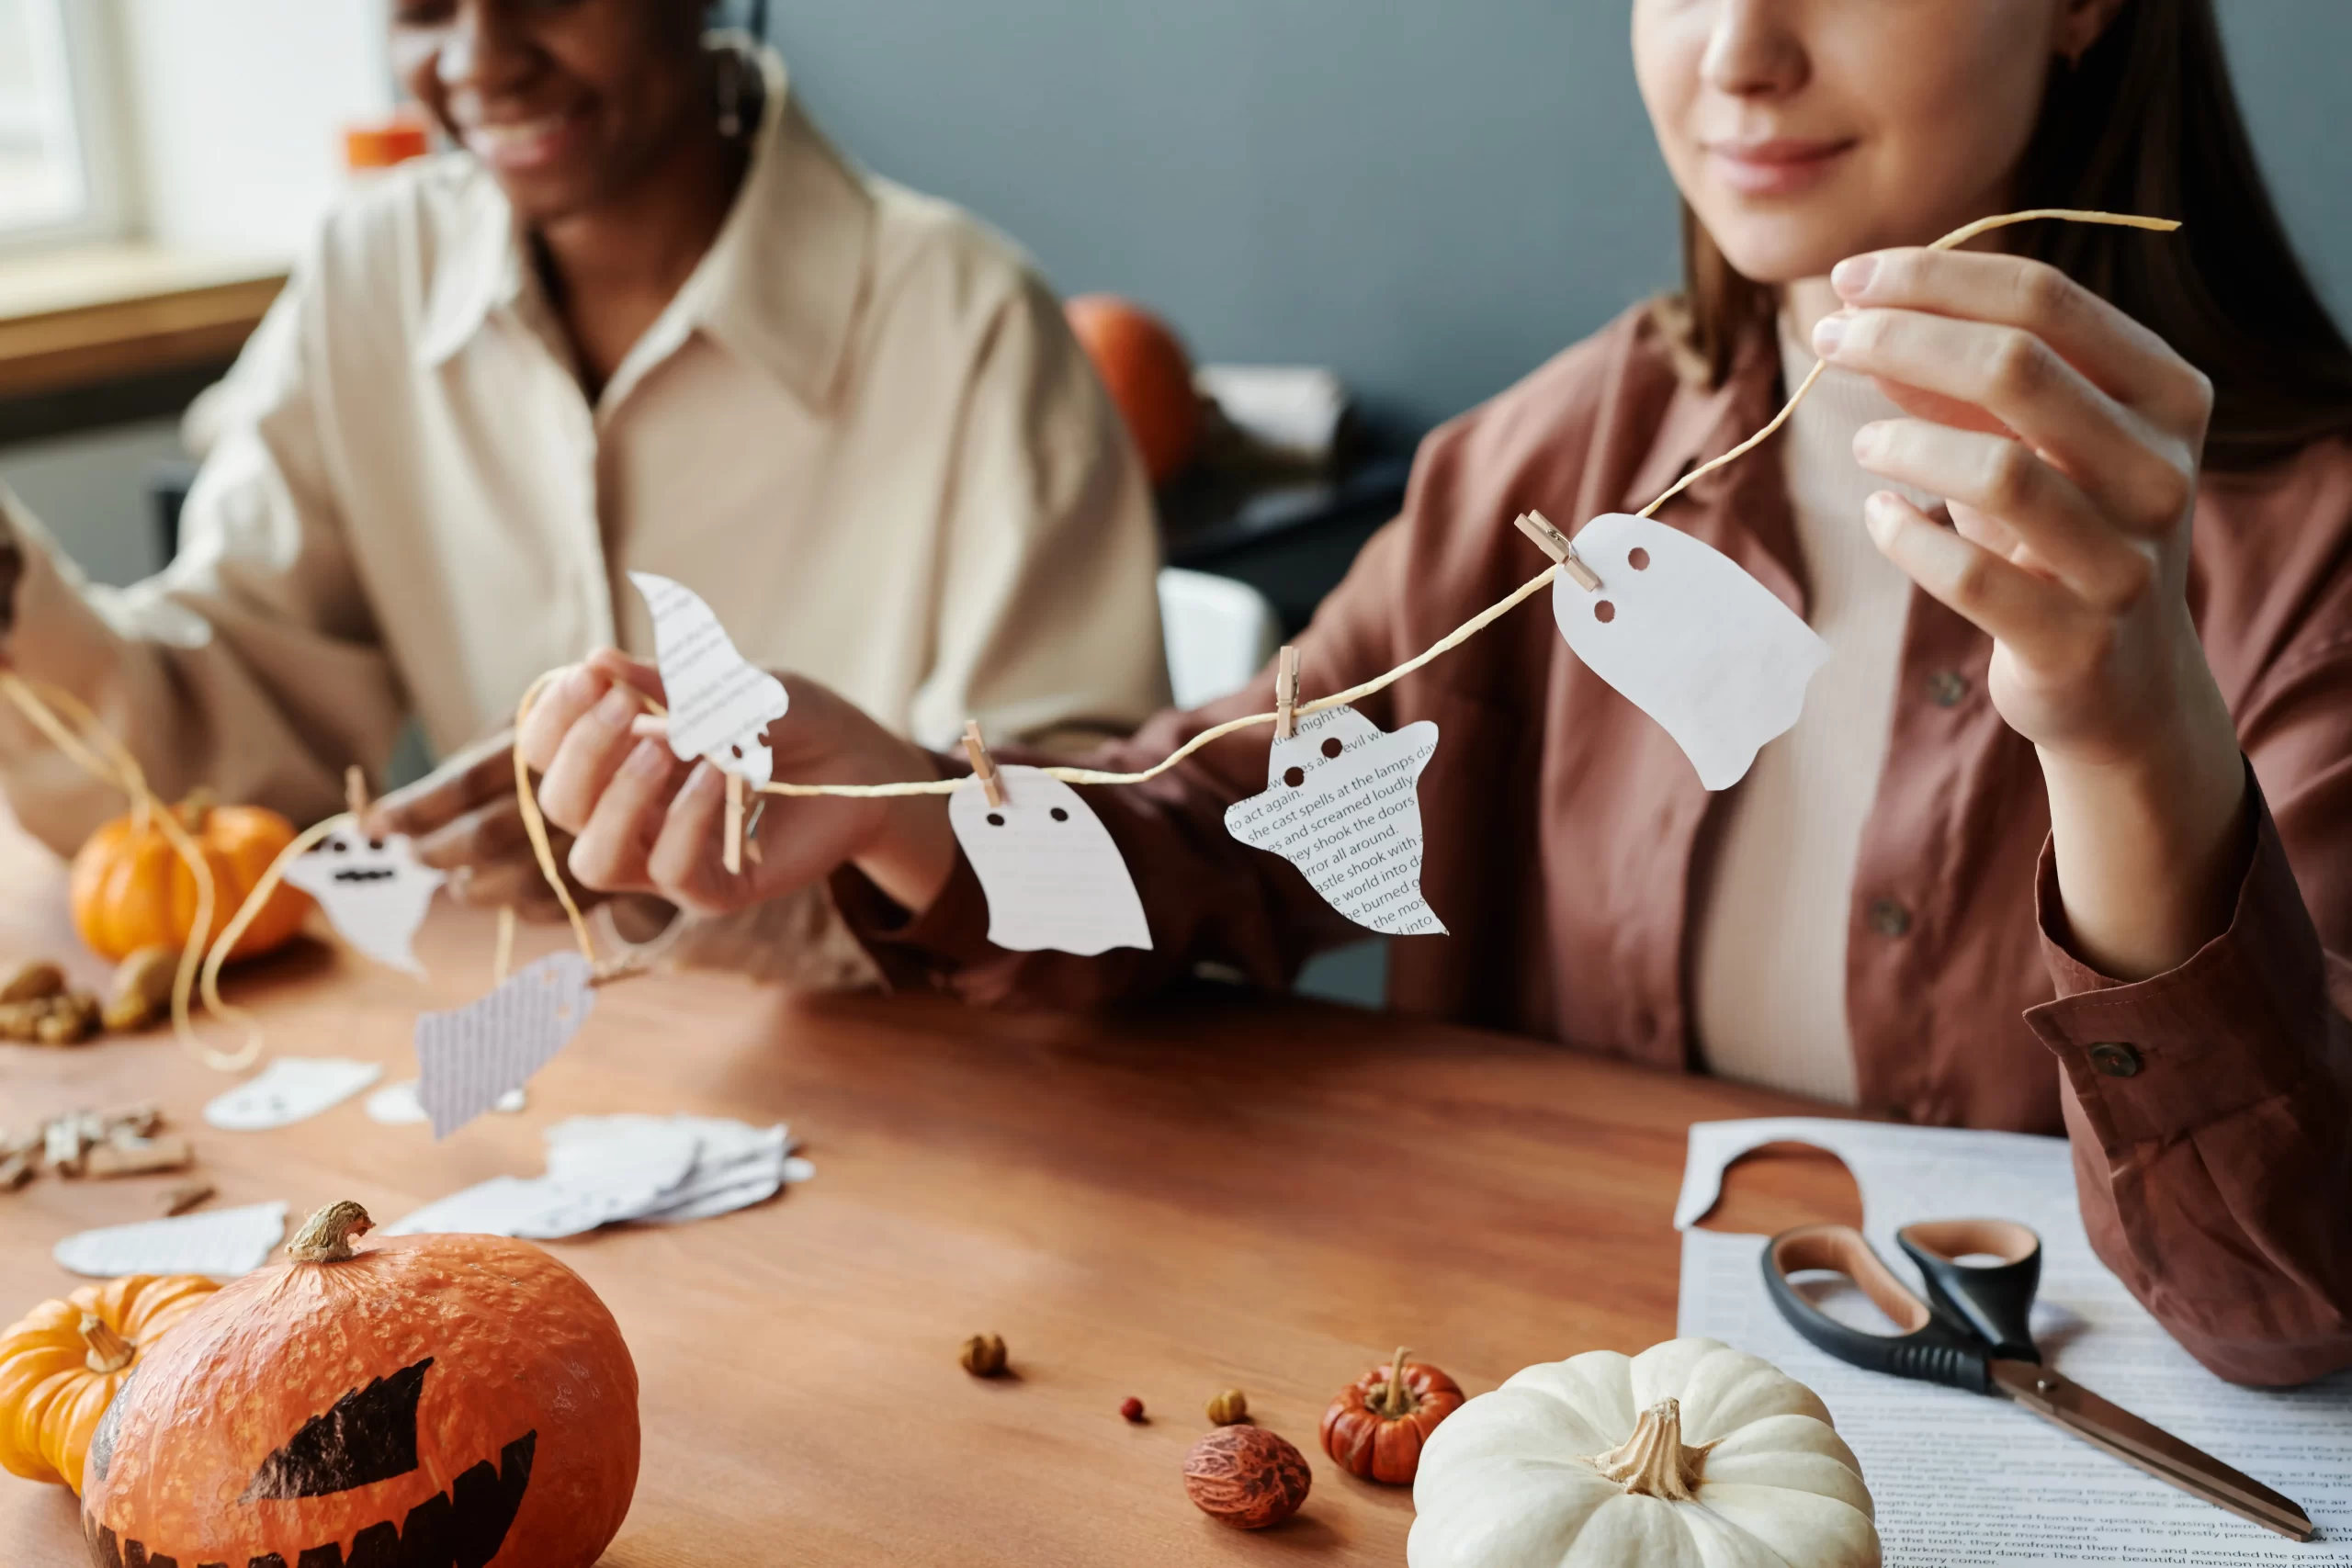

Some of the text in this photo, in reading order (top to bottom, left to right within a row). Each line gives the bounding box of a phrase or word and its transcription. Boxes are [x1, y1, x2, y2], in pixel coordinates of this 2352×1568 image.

[1301, 711, 1337, 732] night
[1337, 705, 1351, 716] to
[1343, 734, 1365, 753] evil
[1229, 820, 1242, 832] to
[1244, 807, 1264, 825] act
[1266, 789, 1305, 814] again.
[1248, 827, 1270, 843] she
[1272, 811, 1298, 830] cast
[1299, 793, 1335, 817] spells
[1337, 784, 1351, 798] at
[1351, 774, 1374, 791] the
[1374, 755, 1415, 779] lamps
[1283, 825, 1309, 846] and
[1311, 794, 1372, 832] screamed
[1373, 775, 1417, 801] loudly.
[1313, 826, 1352, 852] shook
[1353, 815, 1376, 832] the
[1378, 795, 1415, 818] doors
[1332, 848, 1347, 864] all
[1349, 824, 1399, 855] around.
[1347, 852, 1386, 878] shook
[1387, 837, 1417, 857] with
[1342, 874, 1380, 901] world
[1380, 863, 1408, 882] into
[1362, 881, 1409, 913] burned
[1374, 912, 1396, 929] the
[1405, 916, 1432, 935] into
[1928, 1529, 2011, 1538] inexplicable
[1951, 1519, 1981, 1528] they
[2044, 1523, 2088, 1532] longer
[2168, 1529, 2220, 1538] ghostly
[2162, 1519, 2216, 1529] causing
[1900, 1546, 1962, 1554] darkness
[1996, 1550, 2049, 1559] danger.
[2053, 1551, 2077, 1560] The
[2082, 1554, 2186, 1564] once-beautiful
[2190, 1558, 2252, 1567] mansion
[1908, 1555, 1948, 1563] every
[1951, 1557, 1999, 1565] corner.
[1970, 1540, 2000, 1548] they
[2005, 1541, 2082, 1550] confronted
[2086, 1543, 2119, 1551] their
[2123, 1545, 2157, 1553] fears
[2191, 1549, 2260, 1558] ascended
[2265, 1551, 2288, 1560] the
[2291, 1552, 2335, 1562] grand
